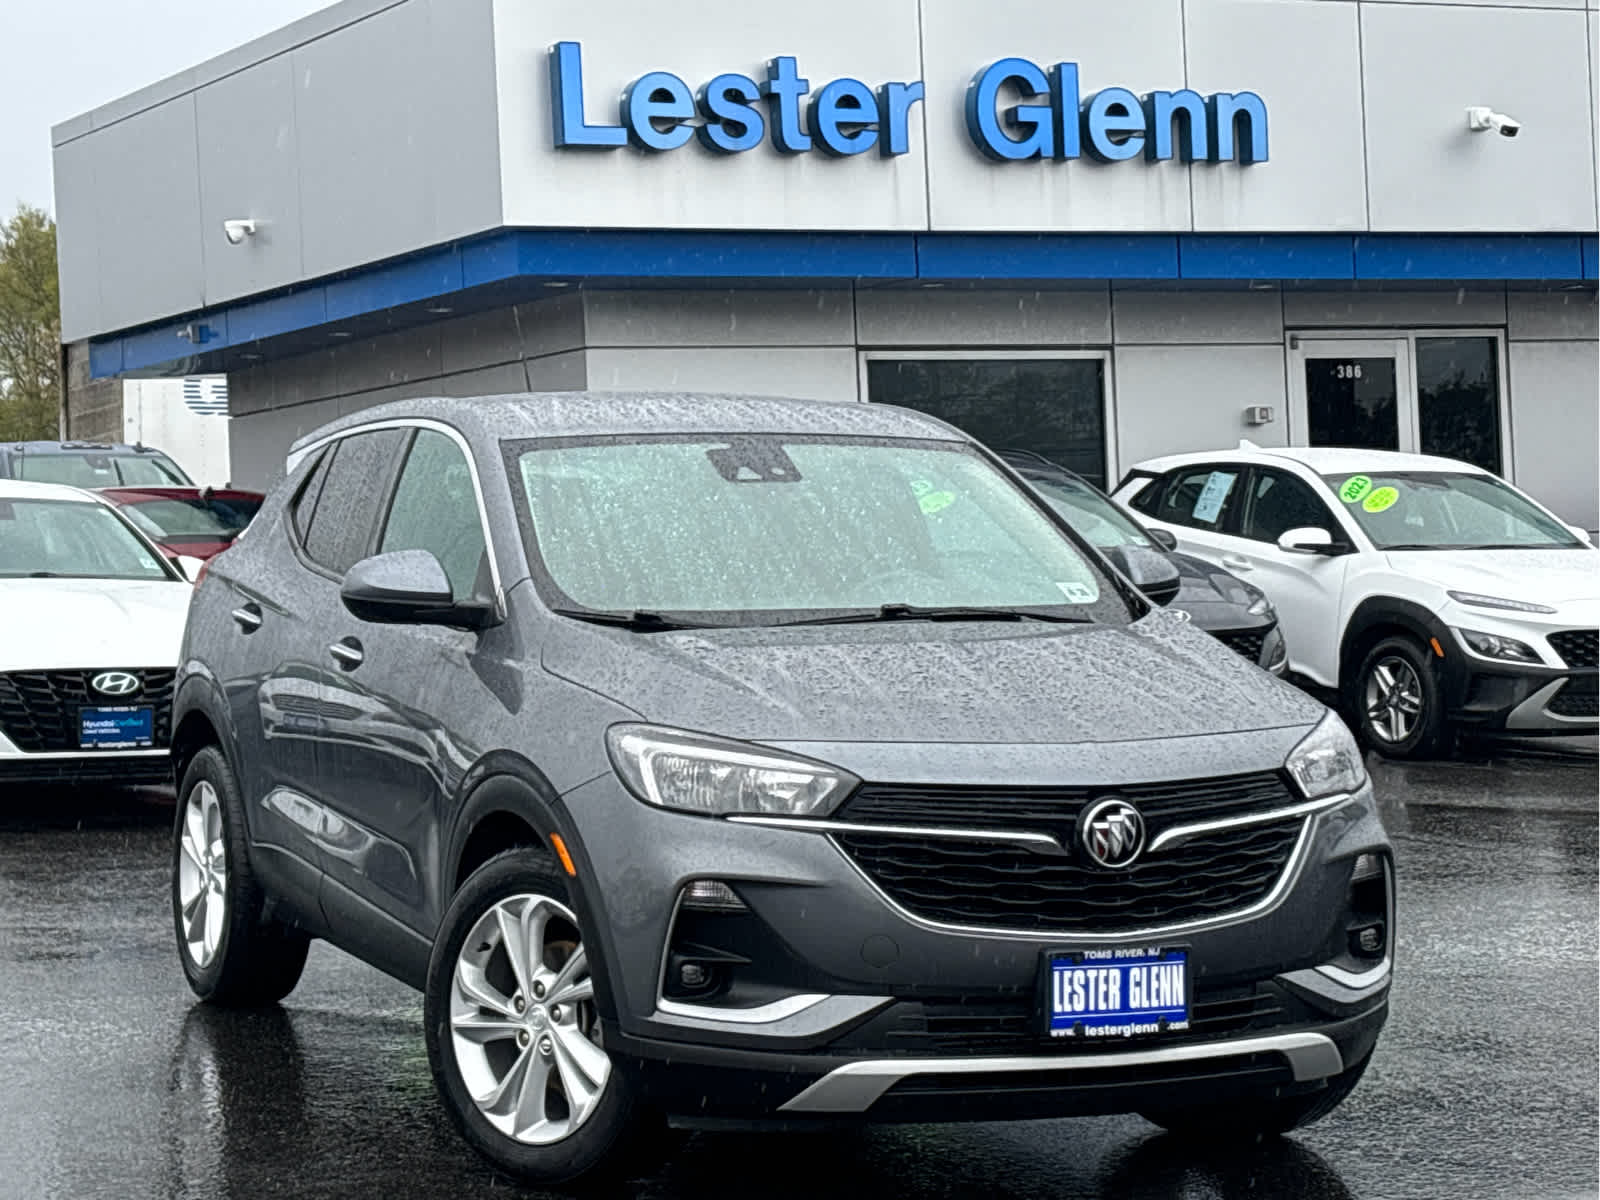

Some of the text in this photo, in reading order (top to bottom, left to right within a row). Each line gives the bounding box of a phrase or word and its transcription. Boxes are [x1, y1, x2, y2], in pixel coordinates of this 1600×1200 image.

[548, 41, 1269, 163] Lester Glenn
[1337, 364, 1362, 379] 386
[1083, 950, 1112, 960] TOMS
[1148, 946, 1160, 957] NJ
[1053, 964, 1185, 1013] LESTER GLENN
